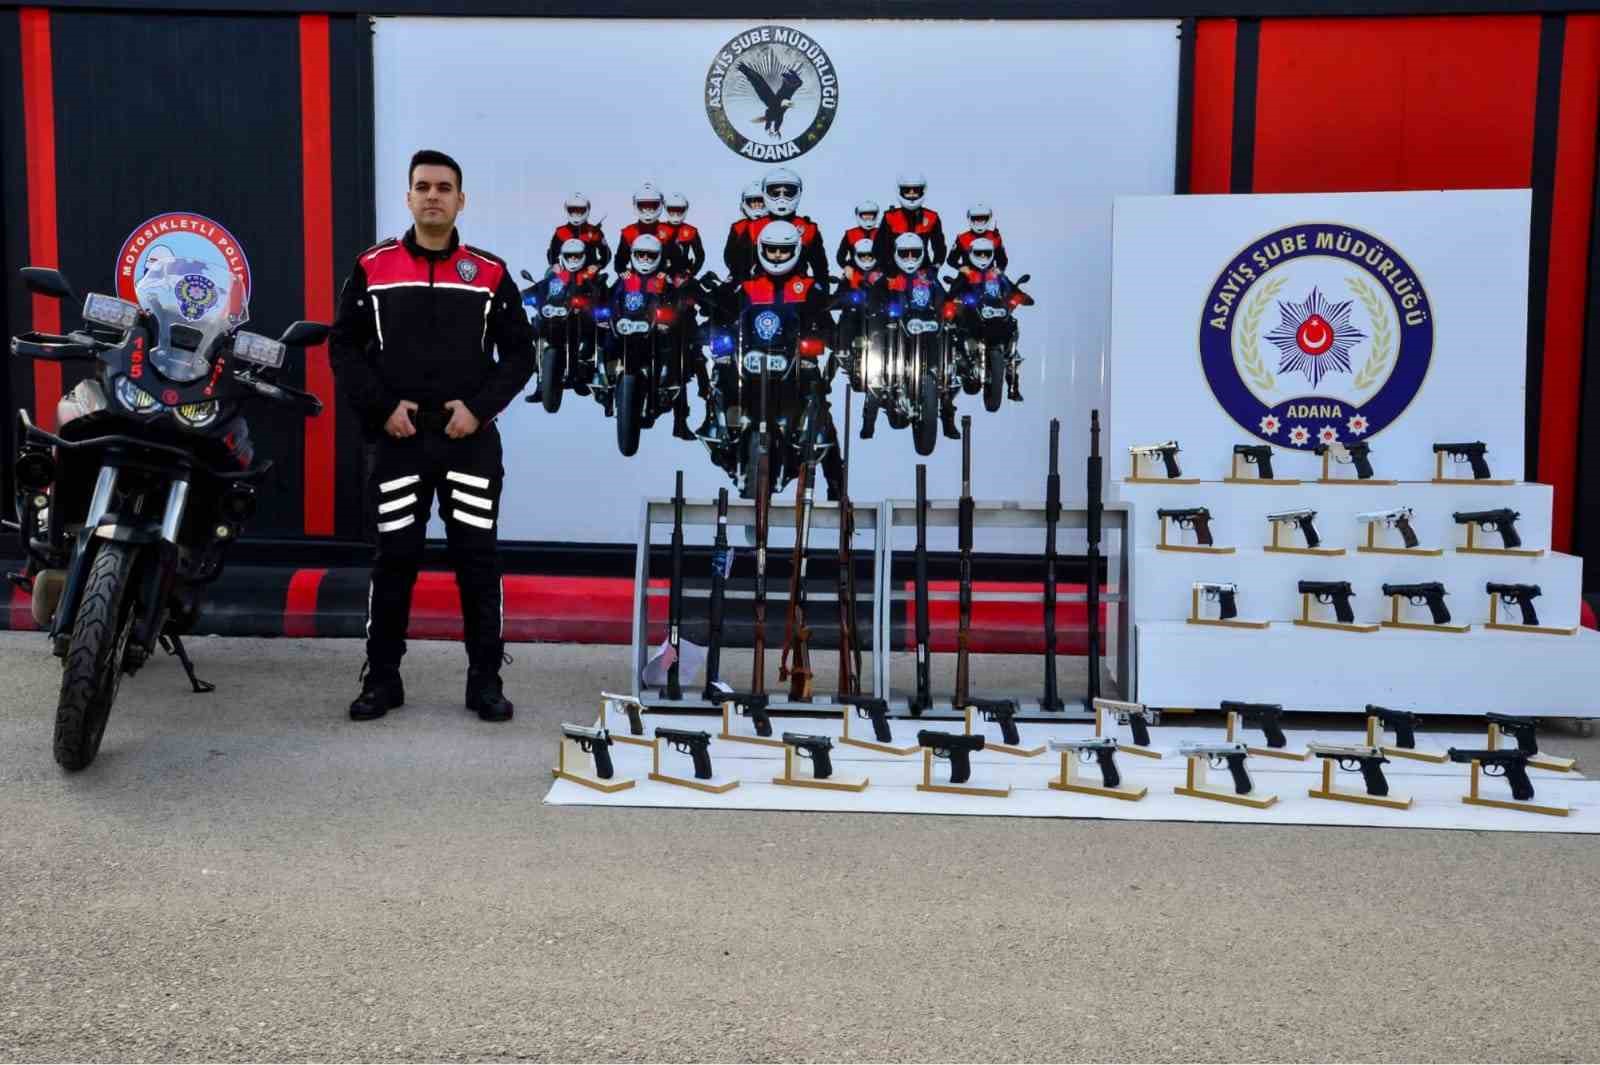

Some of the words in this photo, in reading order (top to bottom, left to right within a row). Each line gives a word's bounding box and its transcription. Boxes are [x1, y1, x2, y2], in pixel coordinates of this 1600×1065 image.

[741, 141, 801, 160] ADANA
[1210, 262, 1257, 330] ASAYİŞ
[1252, 233, 1308, 269] ŞUBE
[1315, 231, 1427, 326] MÜDÜRLÜĞÜ
[1286, 404, 1342, 418] ADANA
